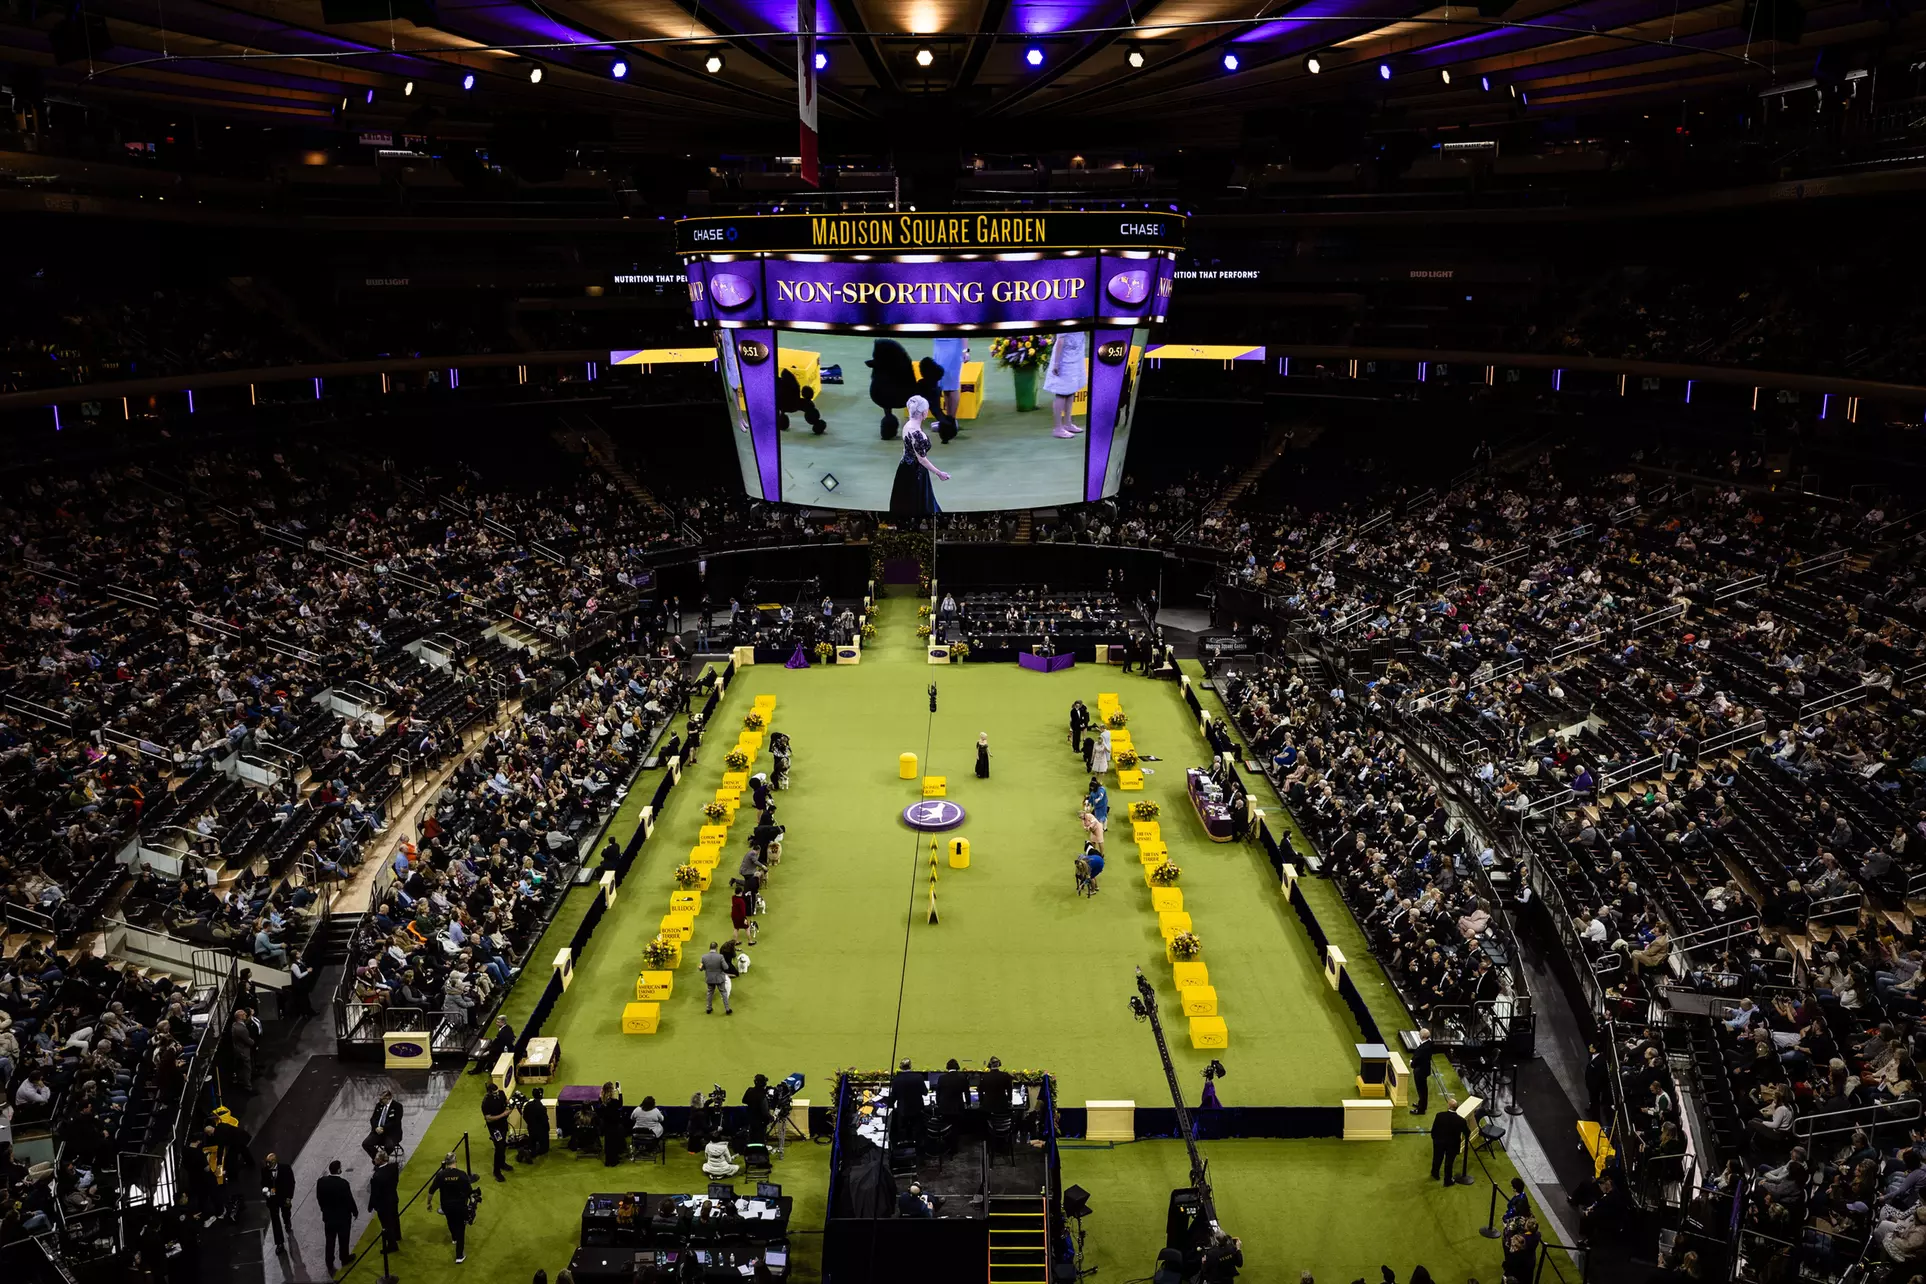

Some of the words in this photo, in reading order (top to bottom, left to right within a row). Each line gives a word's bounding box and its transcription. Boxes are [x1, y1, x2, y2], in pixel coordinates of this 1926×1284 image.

[693, 229, 724, 241] CHASE
[812, 217, 893, 245] MADISON
[900, 216, 970, 246] SQUARE
[977, 215, 1045, 243] GARDEN
[1120, 223, 1159, 235] CHASE
[614, 275, 654, 283] NUTRITION
[655, 275, 674, 283] THAT
[1410, 270, 1428, 278] BUD
[1428, 270, 1453, 278] LIGHT
[777, 280, 985, 304] NON-SPORTING
[991, 277, 1086, 303] GROUP
[742, 345, 759, 357] 9:51
[1108, 346, 1123, 357] 9:51
